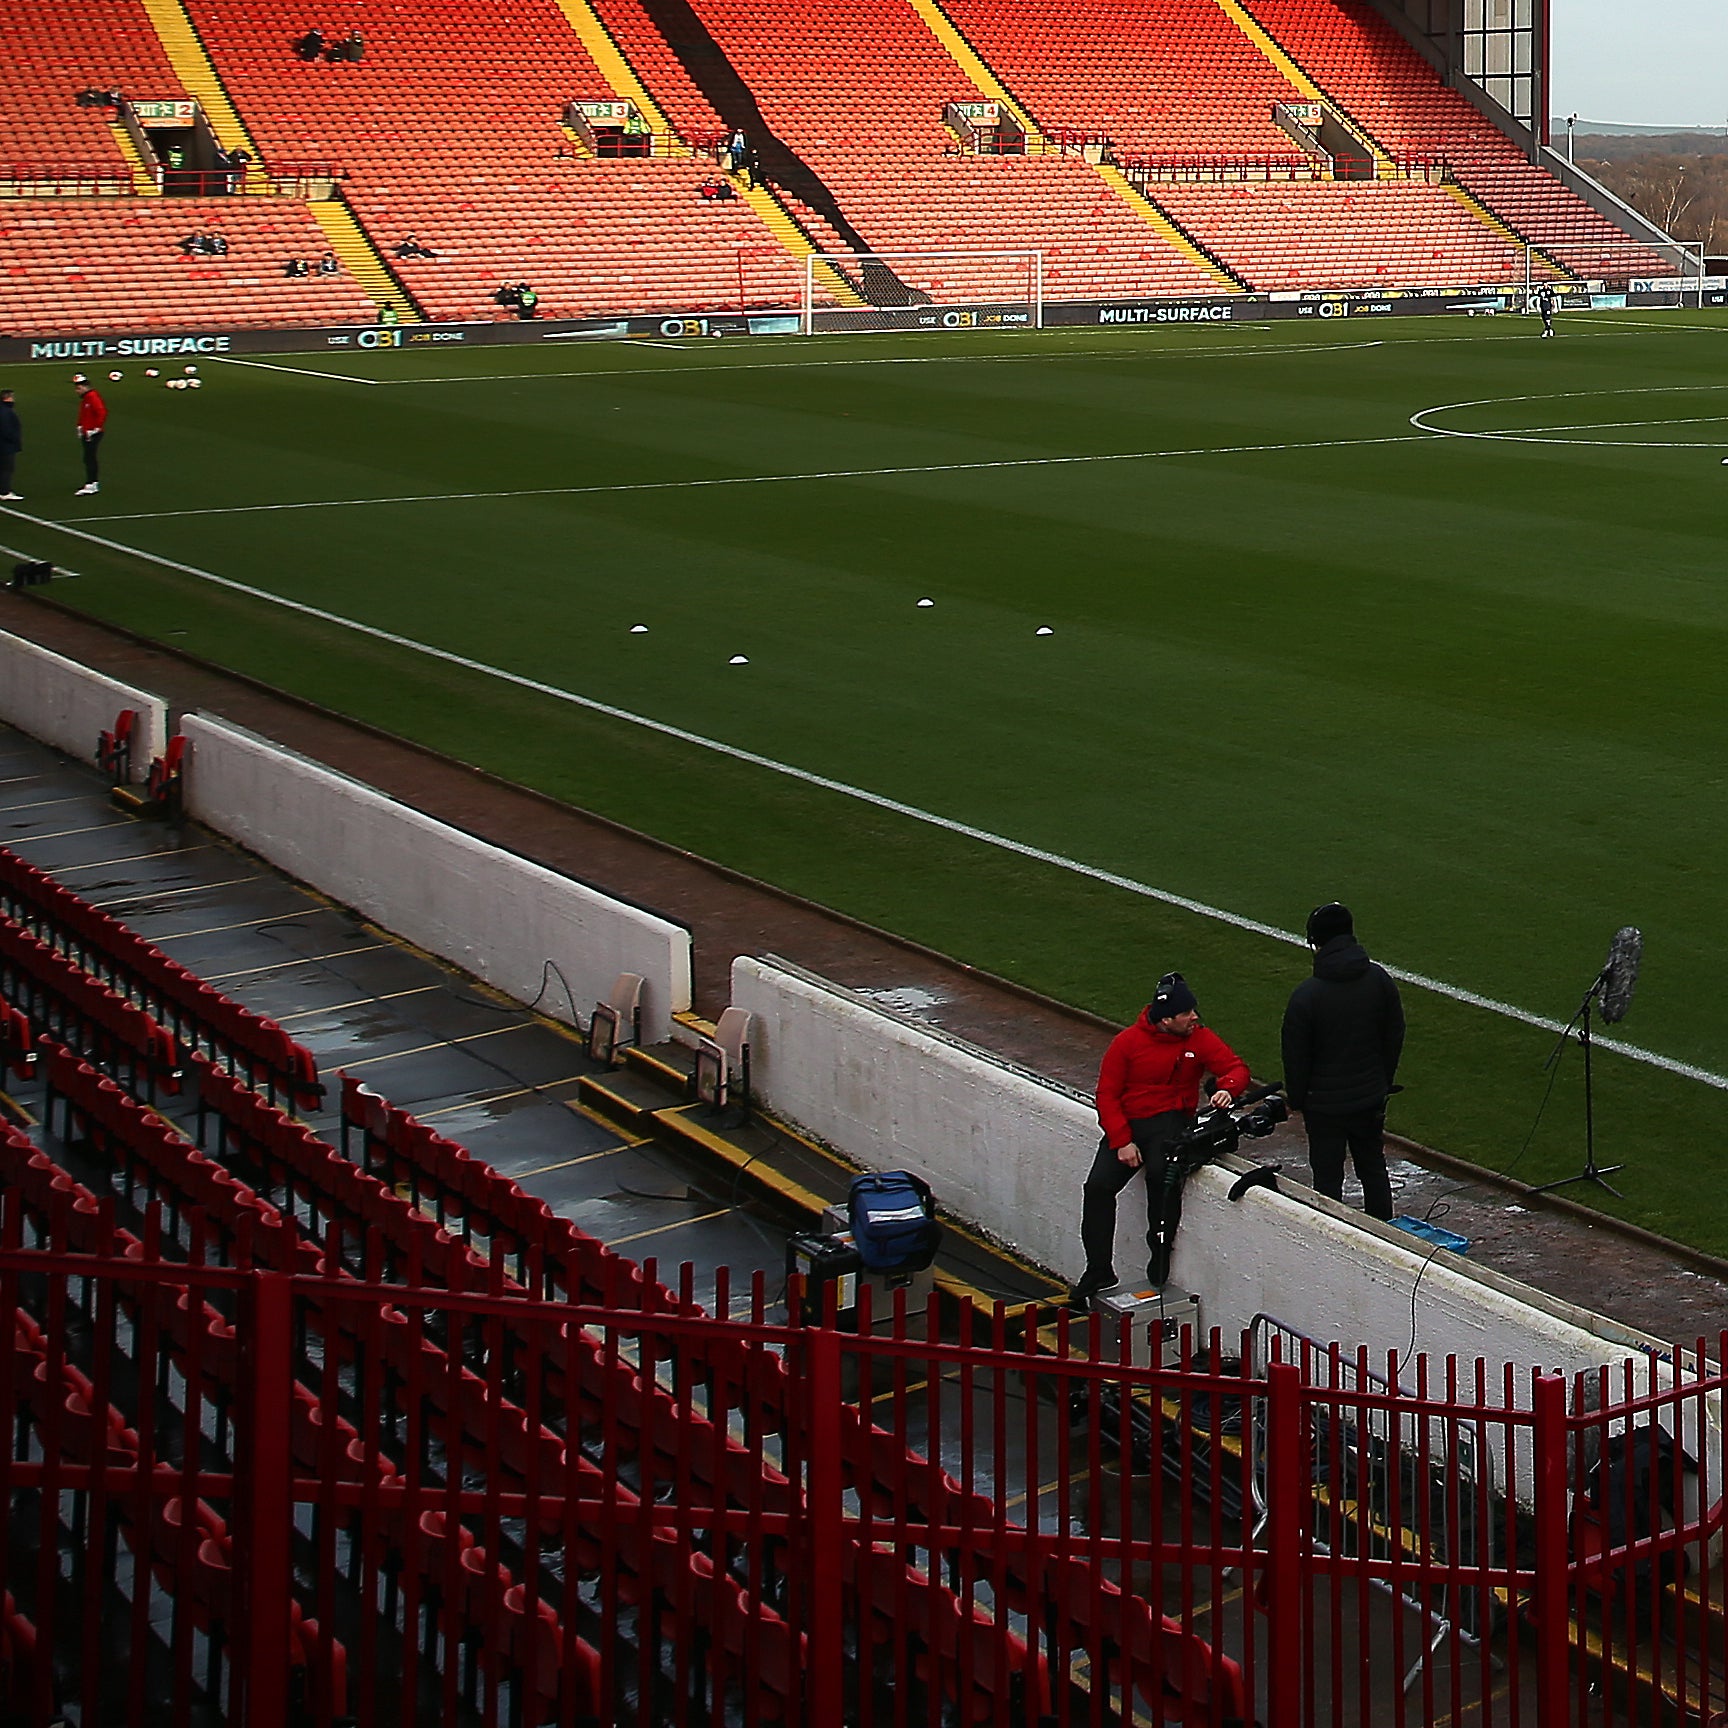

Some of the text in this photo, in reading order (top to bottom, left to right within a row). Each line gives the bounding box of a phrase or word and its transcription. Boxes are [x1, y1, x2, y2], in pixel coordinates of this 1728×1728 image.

[180, 104, 191, 115] 2
[616, 105, 626, 116] 3
[986, 106, 996, 115] 4
[1311, 107, 1318, 117] 5
[1634, 280, 1654, 292] DX
[1099, 305, 1232, 324] MULTI-SURFACE
[1318, 301, 1349, 319] OB1
[1370, 303, 1392, 313] DONE
[943, 311, 978, 327] OB1
[1002, 313, 1029, 323] DONE
[659, 318, 709, 338] OB1
[357, 329, 403, 349] OB1
[432, 332, 465, 342] DONE
[31, 336, 232, 360] MULTI-SURFACE
